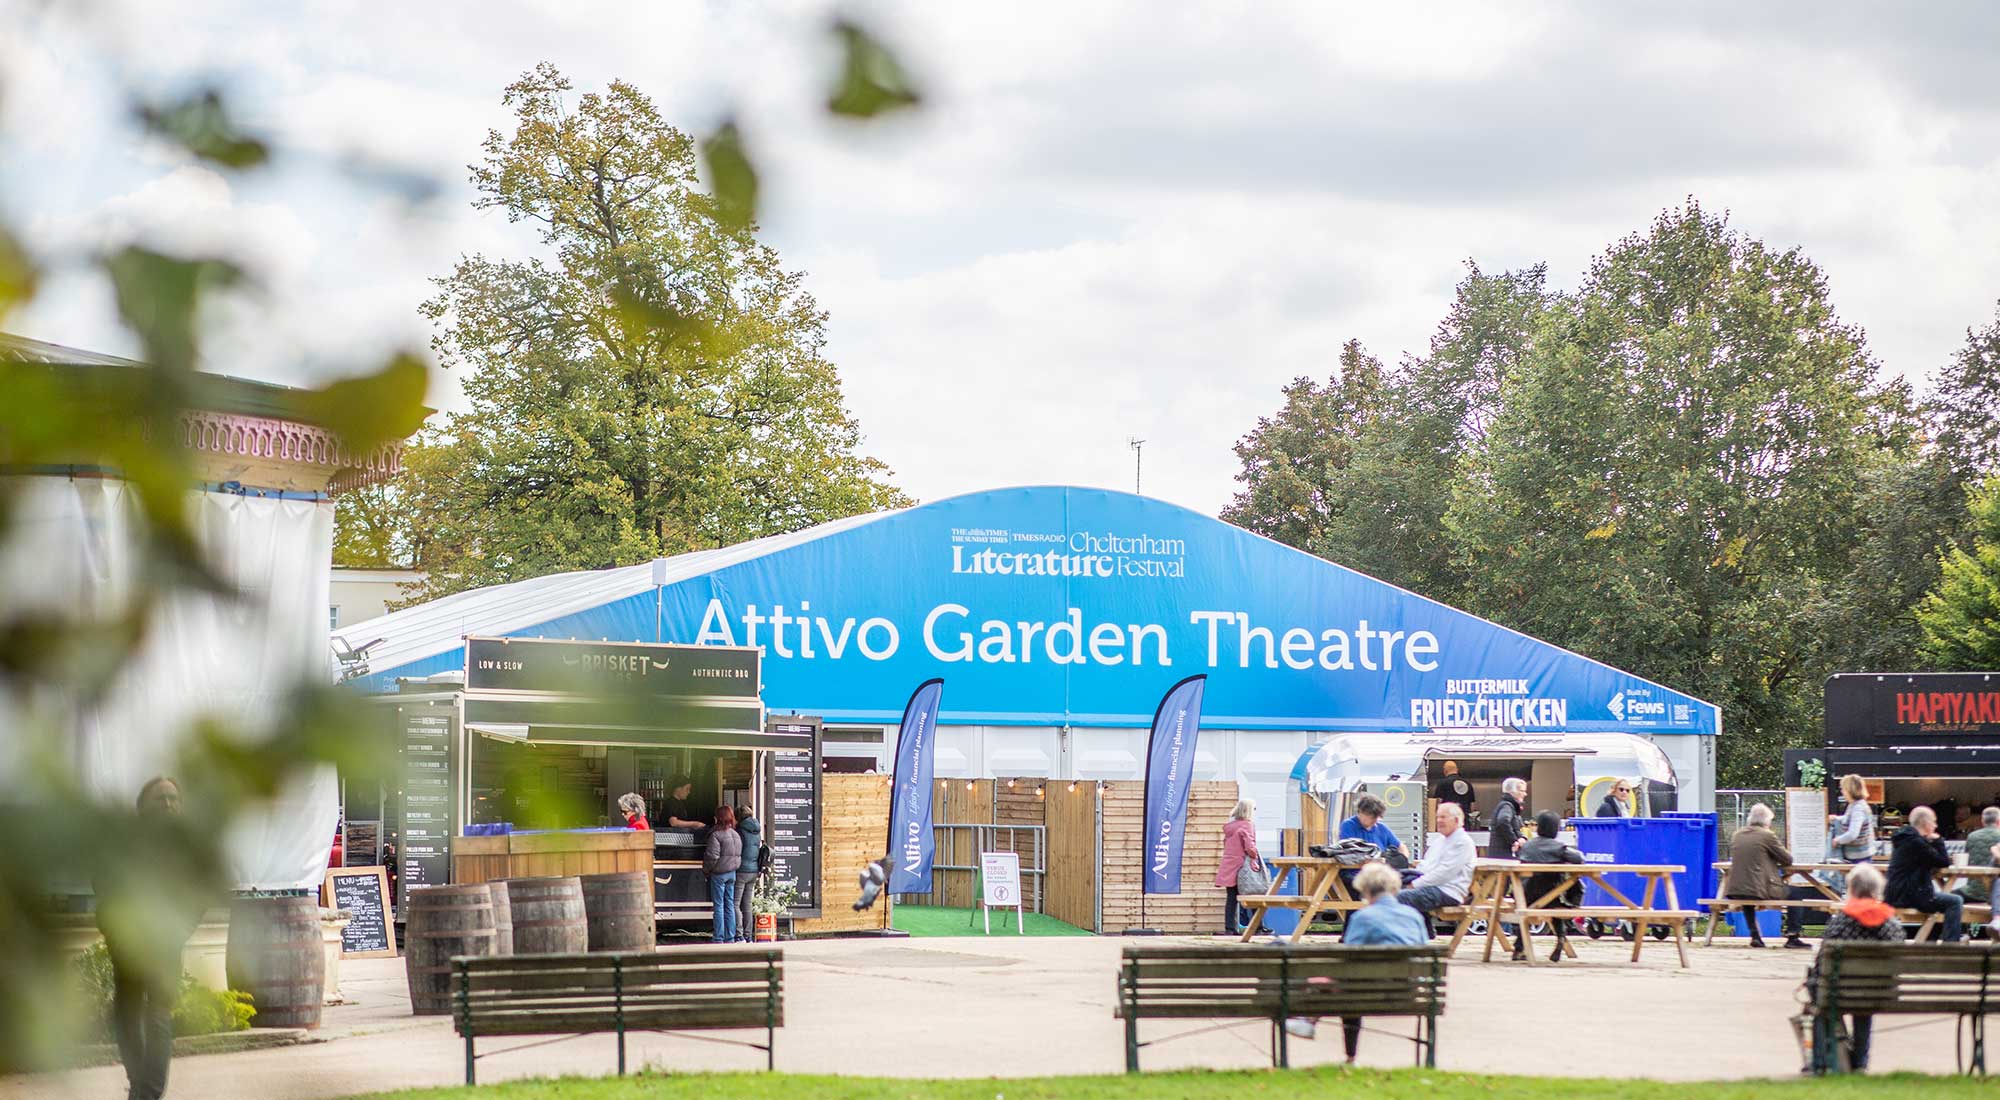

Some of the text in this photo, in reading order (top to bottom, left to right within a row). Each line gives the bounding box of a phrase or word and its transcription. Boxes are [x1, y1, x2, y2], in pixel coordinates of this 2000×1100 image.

[1069, 531, 1185, 556] Cheltenham
[951, 545, 1184, 578] Literature Festival
[695, 598, 1440, 673] Attivo Garden Theatre
[478, 660, 523, 671] LOW & SLOW
[581, 654, 651, 676] BRISKET
[692, 668, 749, 679] AUTHENTIC BBQ
[1446, 679, 1529, 695] BUTTERMILK
[1410, 698, 1567, 727] FRIED CHICKEN
[1627, 699, 1665, 714] Fews
[915, 711, 928, 749] planning
[1172, 709, 1187, 745] planning
[910, 750, 920, 784] financial
[1167, 747, 1180, 781] financial
[903, 821, 922, 879] Attivo
[1151, 820, 1172, 880] Attivo
